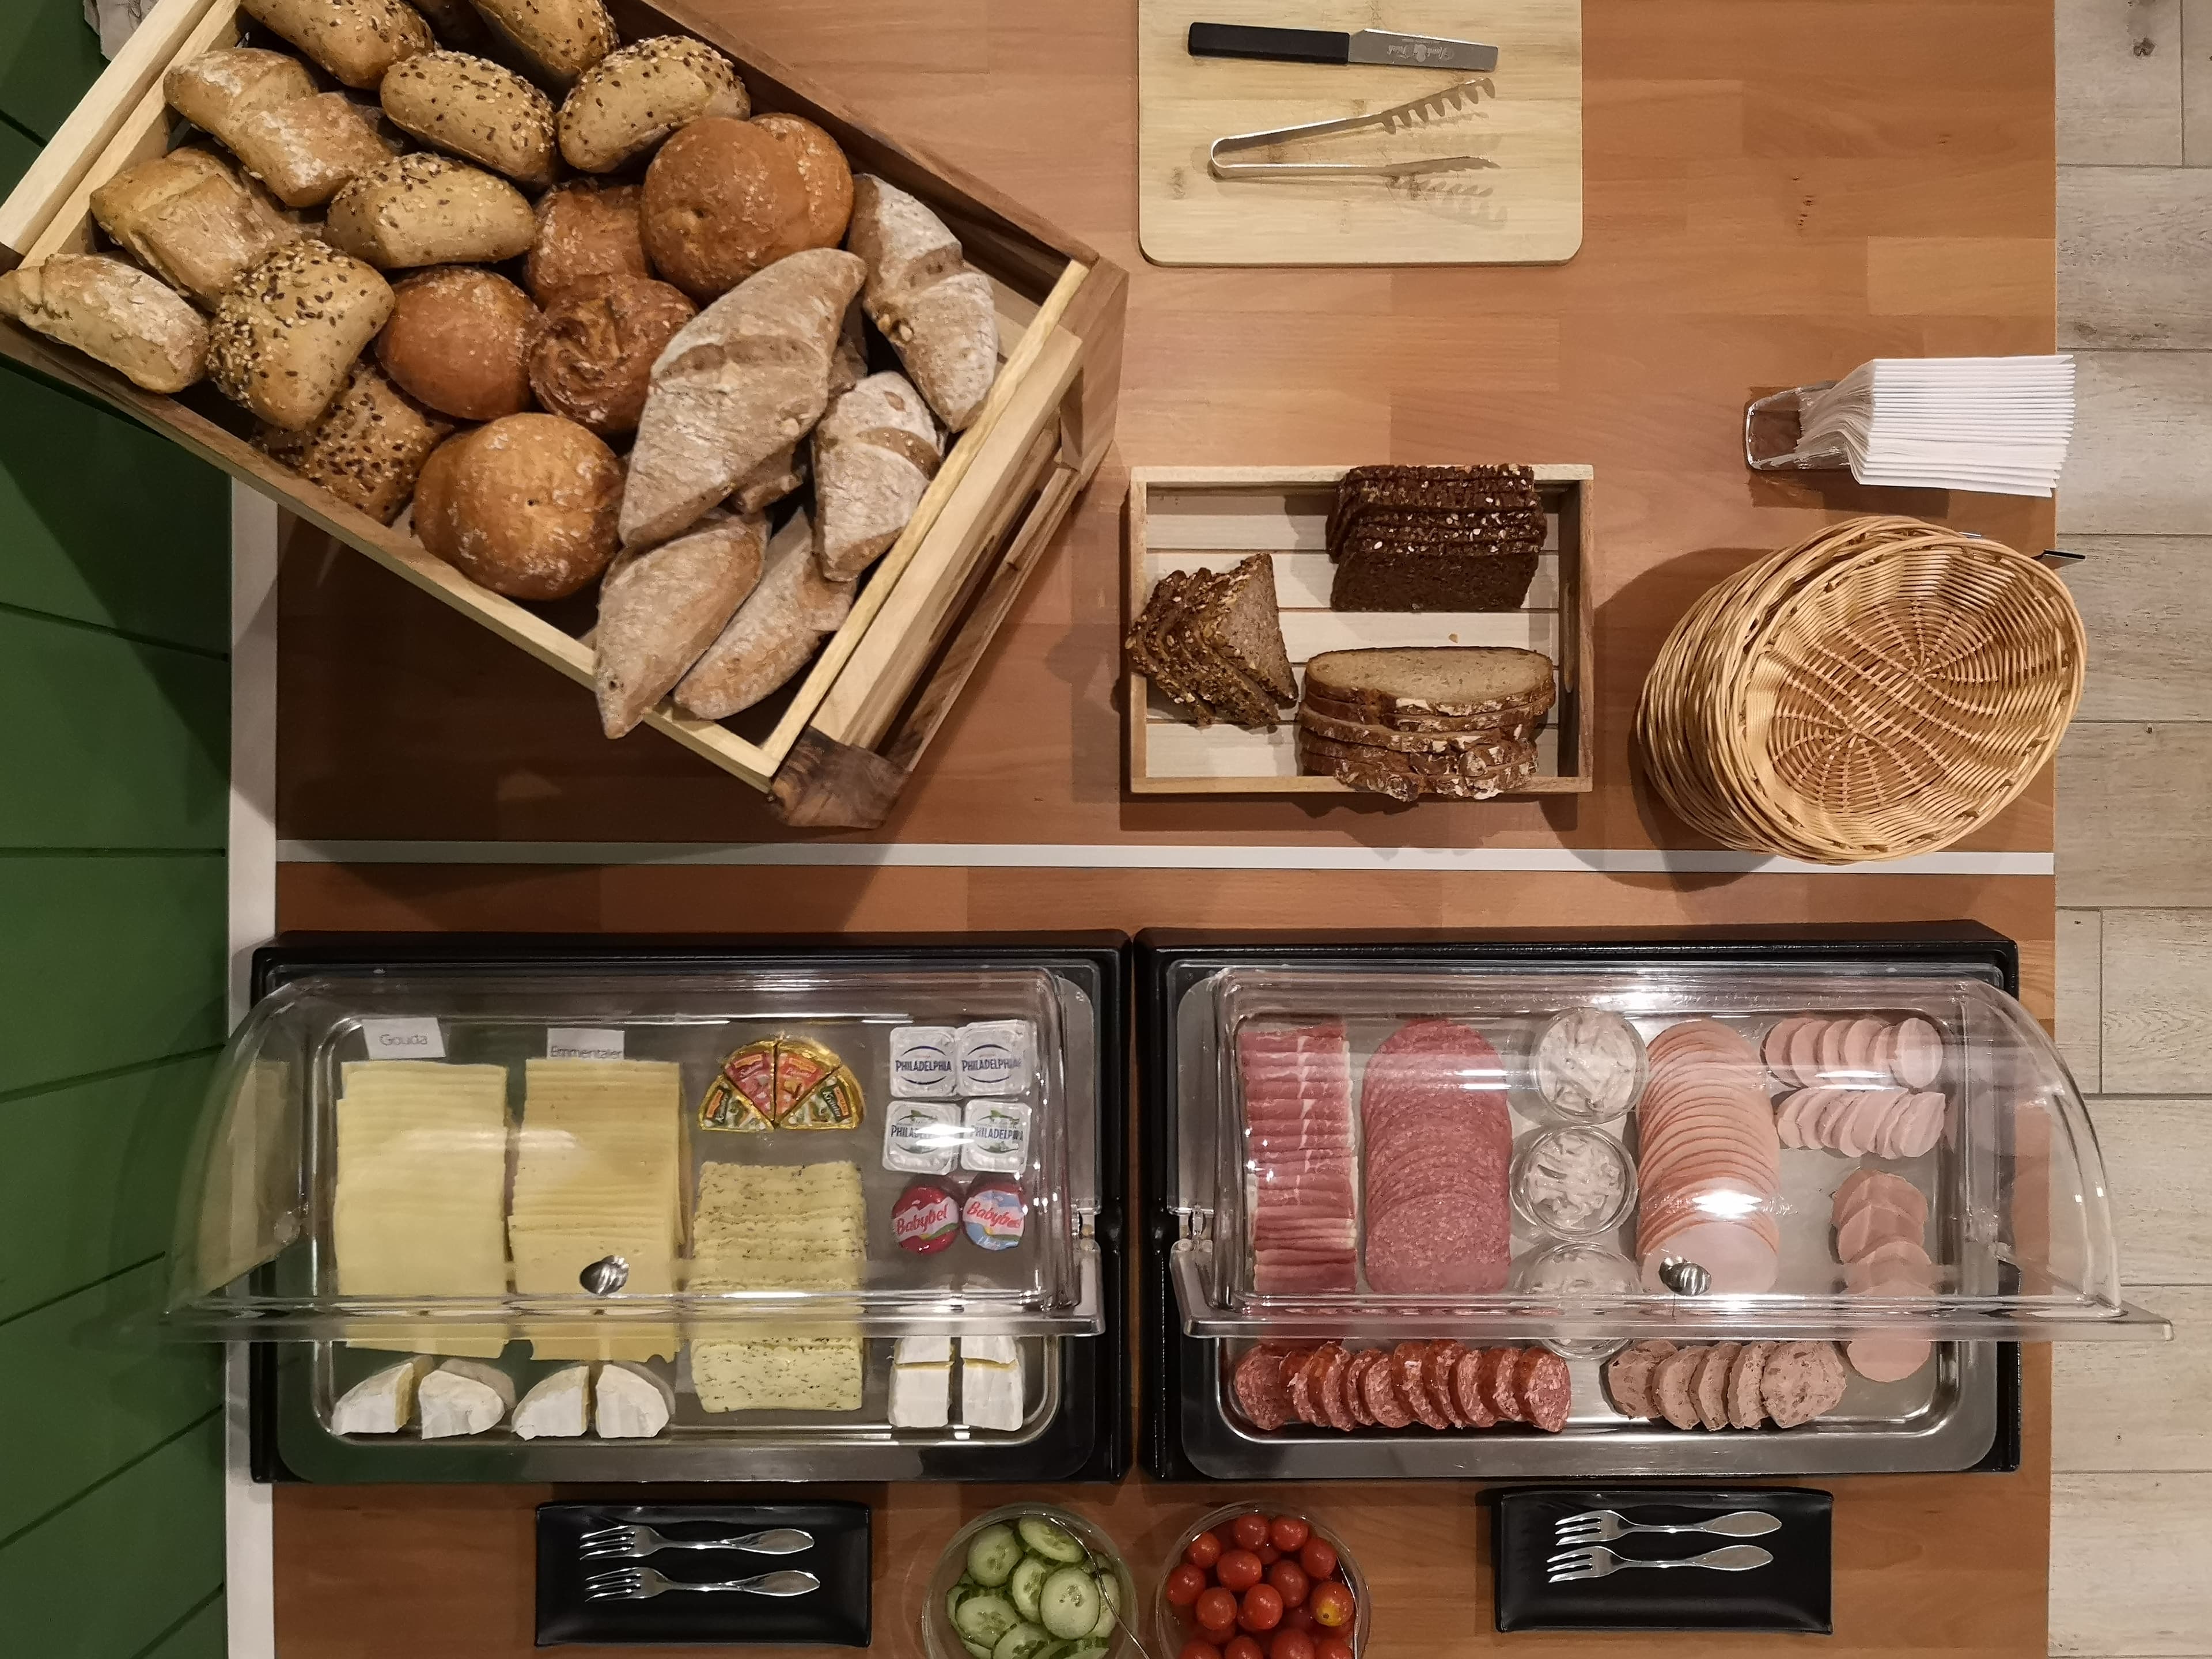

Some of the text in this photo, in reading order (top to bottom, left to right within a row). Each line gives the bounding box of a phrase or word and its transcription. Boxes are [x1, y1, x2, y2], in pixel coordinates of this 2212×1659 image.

[380, 1034, 427, 1046] Gouda
[895, 1059, 953, 1073] PHILADELPHIA
[961, 1058, 1021, 1072] PHILADELPHIA
[896, 1203, 948, 1235] Babybel
